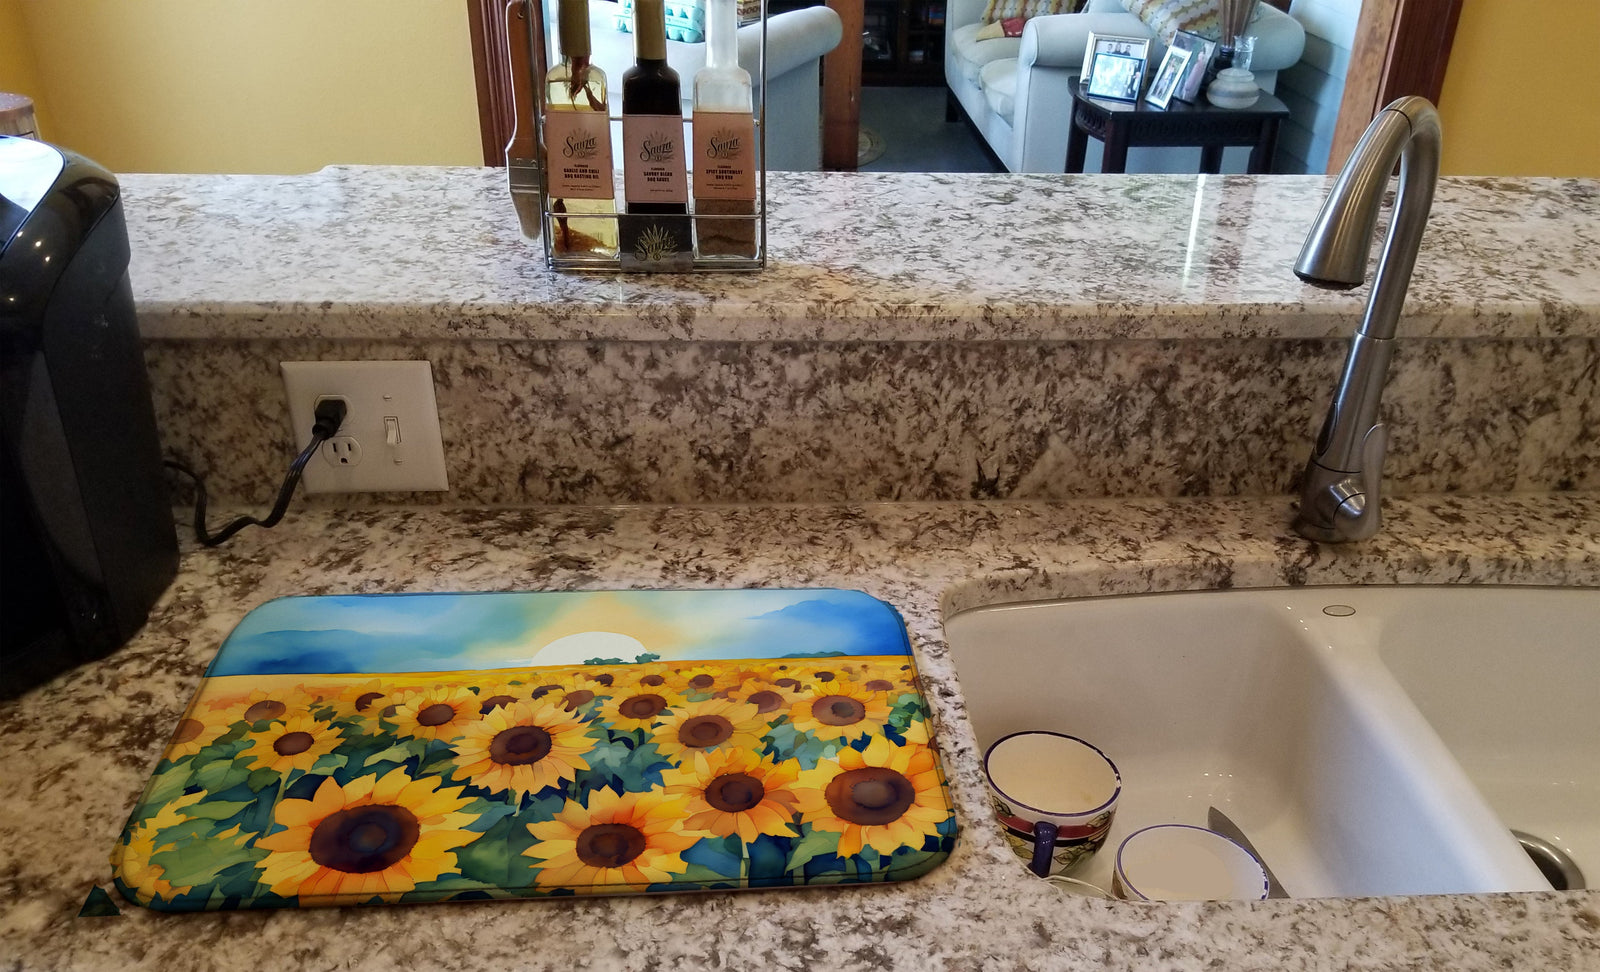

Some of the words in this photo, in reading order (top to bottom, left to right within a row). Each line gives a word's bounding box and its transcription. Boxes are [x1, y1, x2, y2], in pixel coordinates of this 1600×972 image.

[563, 136, 597, 158] Sauza
[640, 140, 673, 161] Sauza
[707, 137, 740, 159] Sauza
